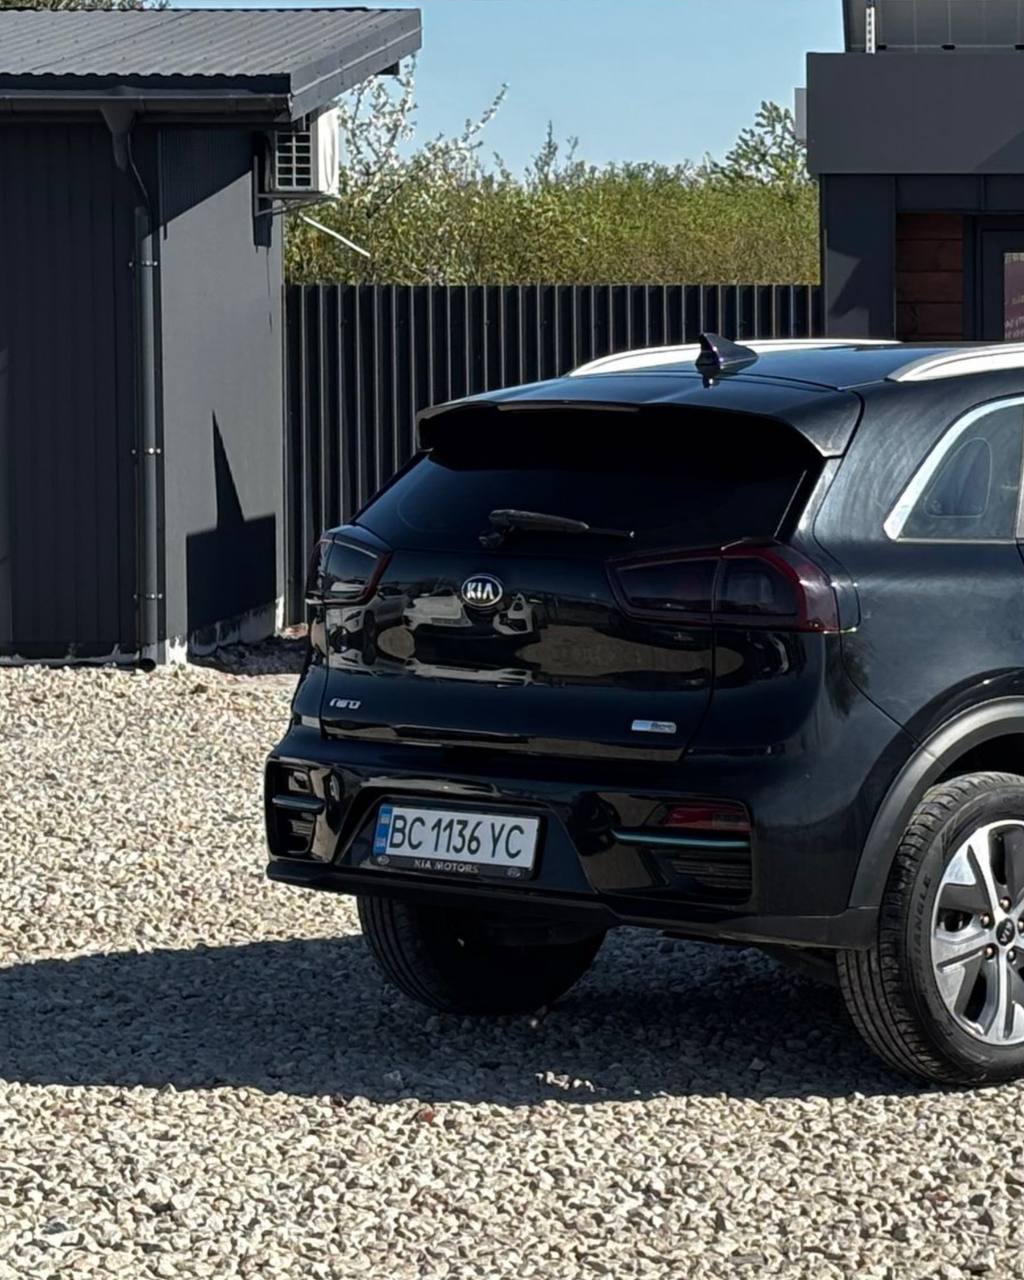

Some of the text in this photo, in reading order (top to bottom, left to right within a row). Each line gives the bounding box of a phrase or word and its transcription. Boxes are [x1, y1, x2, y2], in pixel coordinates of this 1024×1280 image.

[466, 582, 495, 600] KIA
[389, 815, 525, 859] BC 1136 YC
[414, 859, 480, 874] KIA MOTORS
